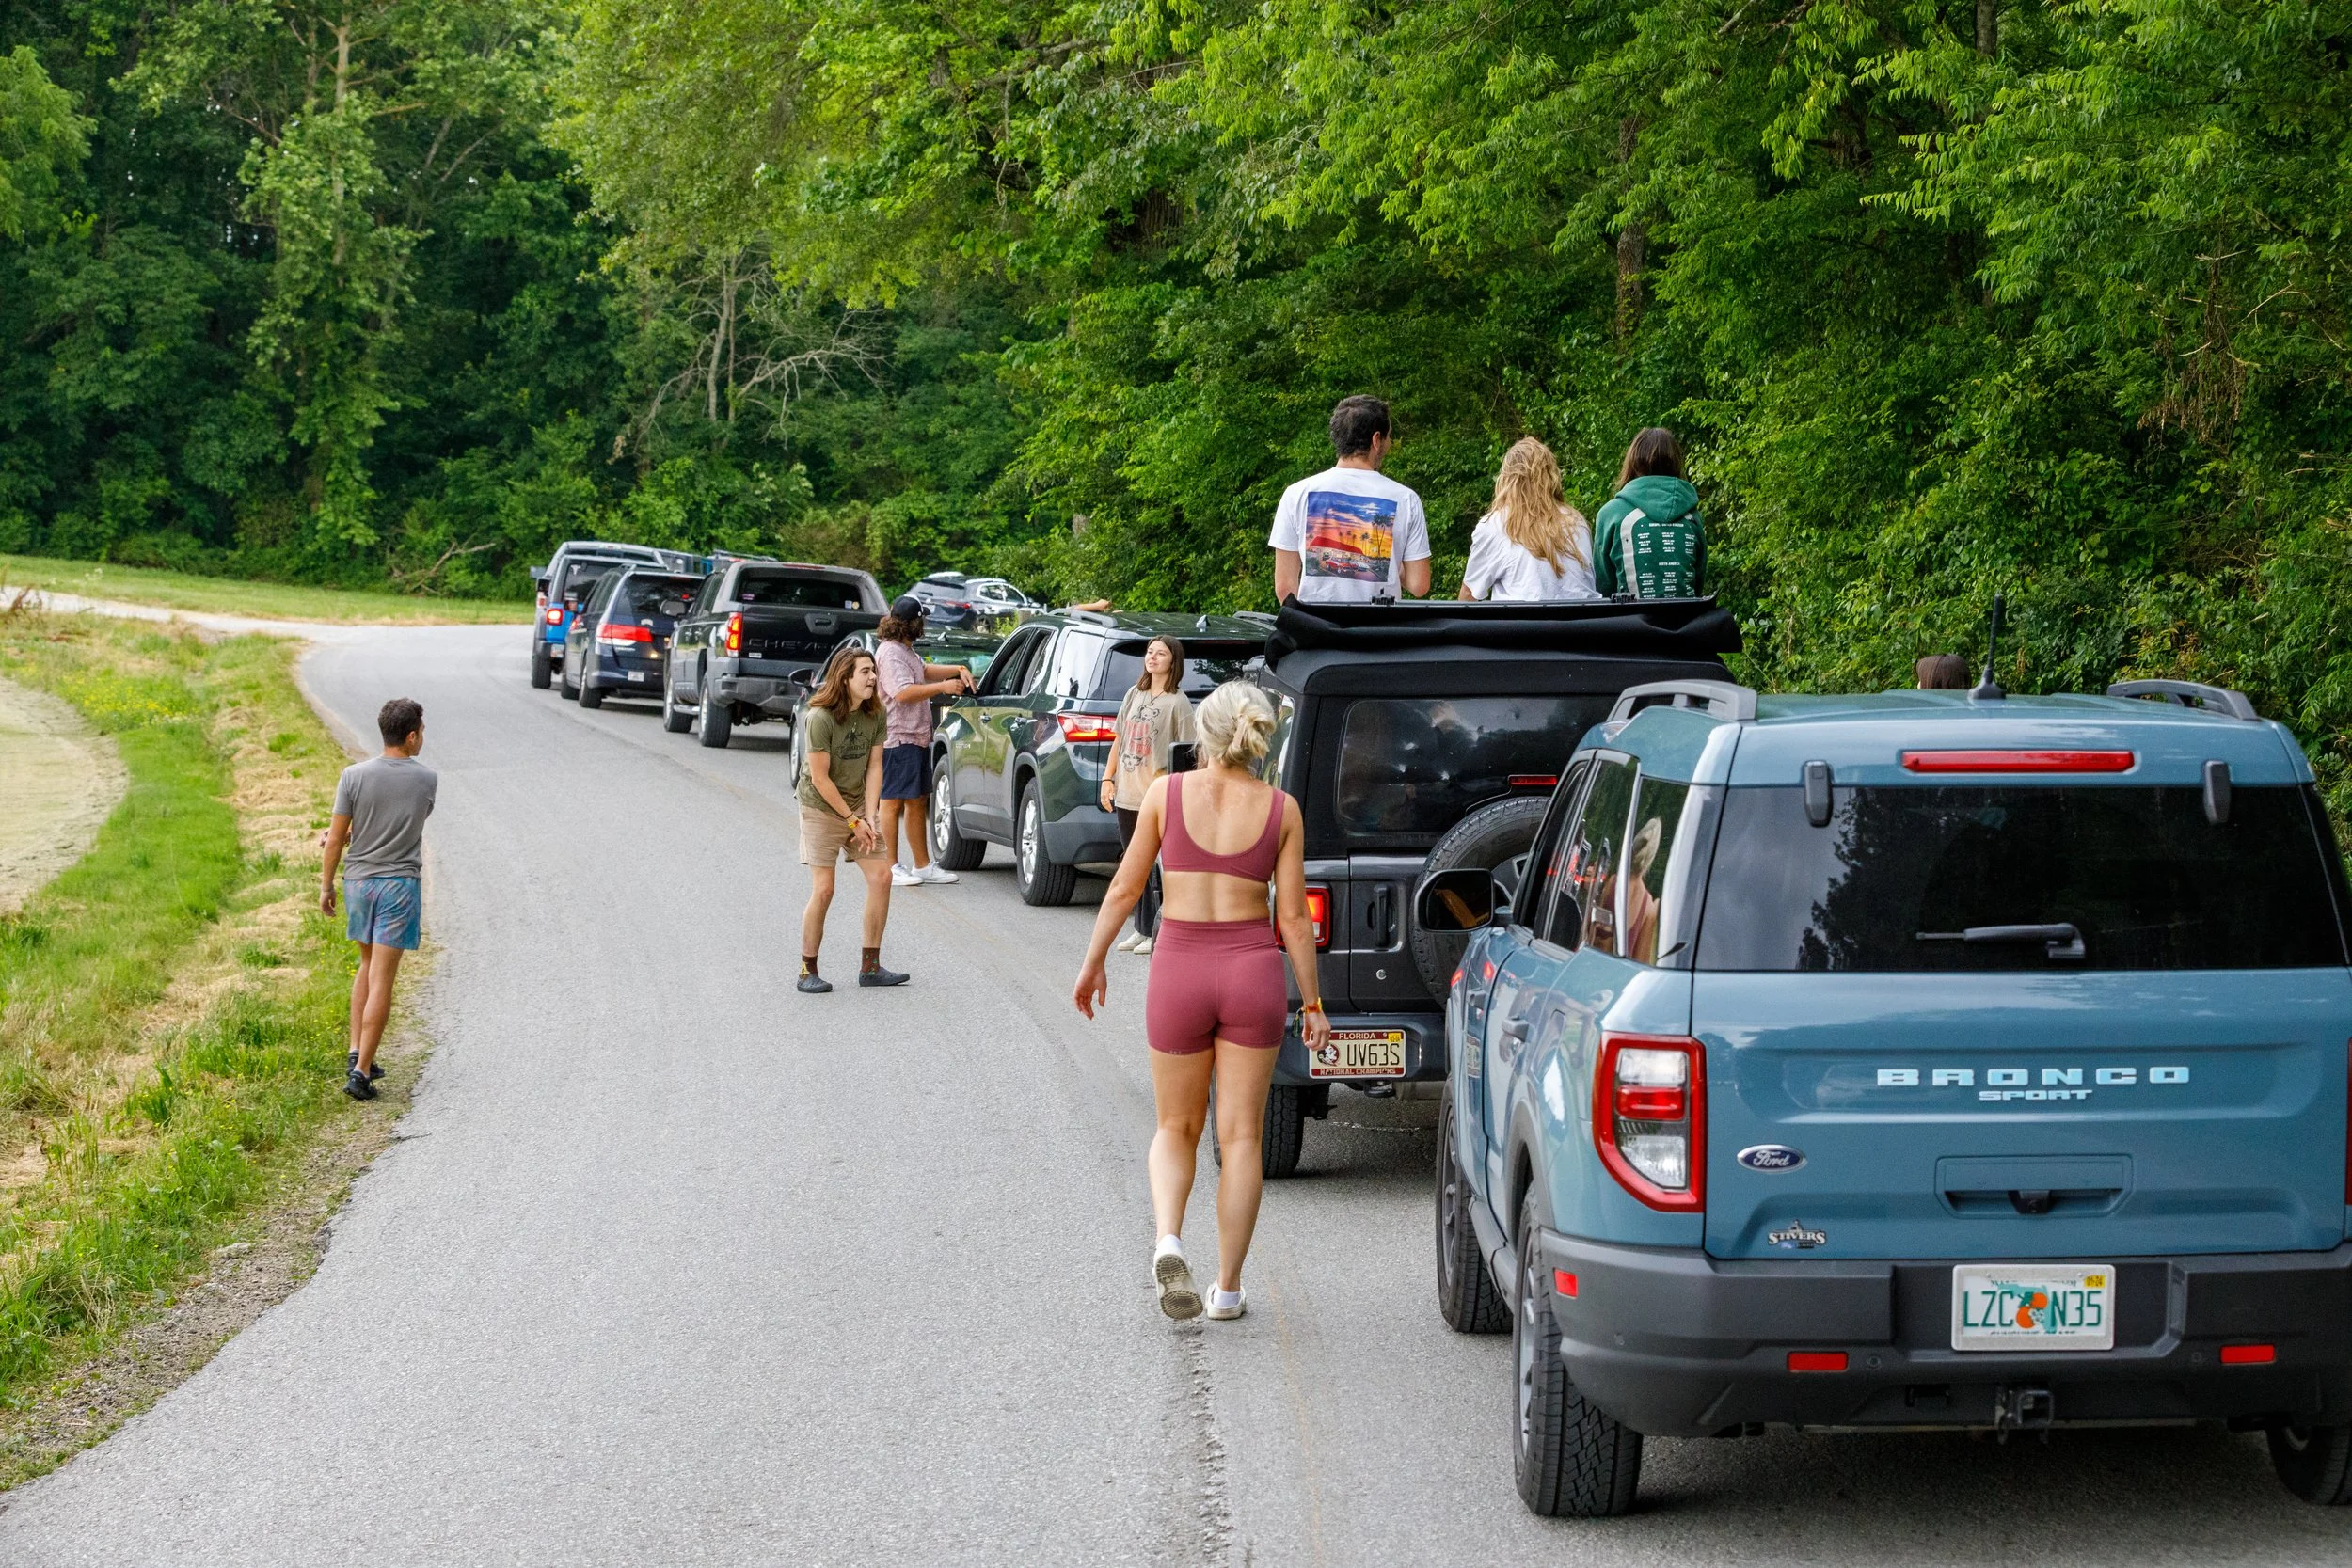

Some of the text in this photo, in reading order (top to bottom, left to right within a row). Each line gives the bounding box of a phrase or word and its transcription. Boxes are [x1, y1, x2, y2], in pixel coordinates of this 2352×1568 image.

[1338, 1032, 1376, 1040] FLORIDA
[1346, 1043, 1400, 1066] UV63S
[1876, 1066, 2190, 1086] BRONCO
[1979, 1089, 2093, 1101] SPORT
[1753, 1150, 1789, 1167] Ford
[1768, 1230, 1826, 1245] STIVERS
[1963, 1291, 2102, 1327] LZC N35
